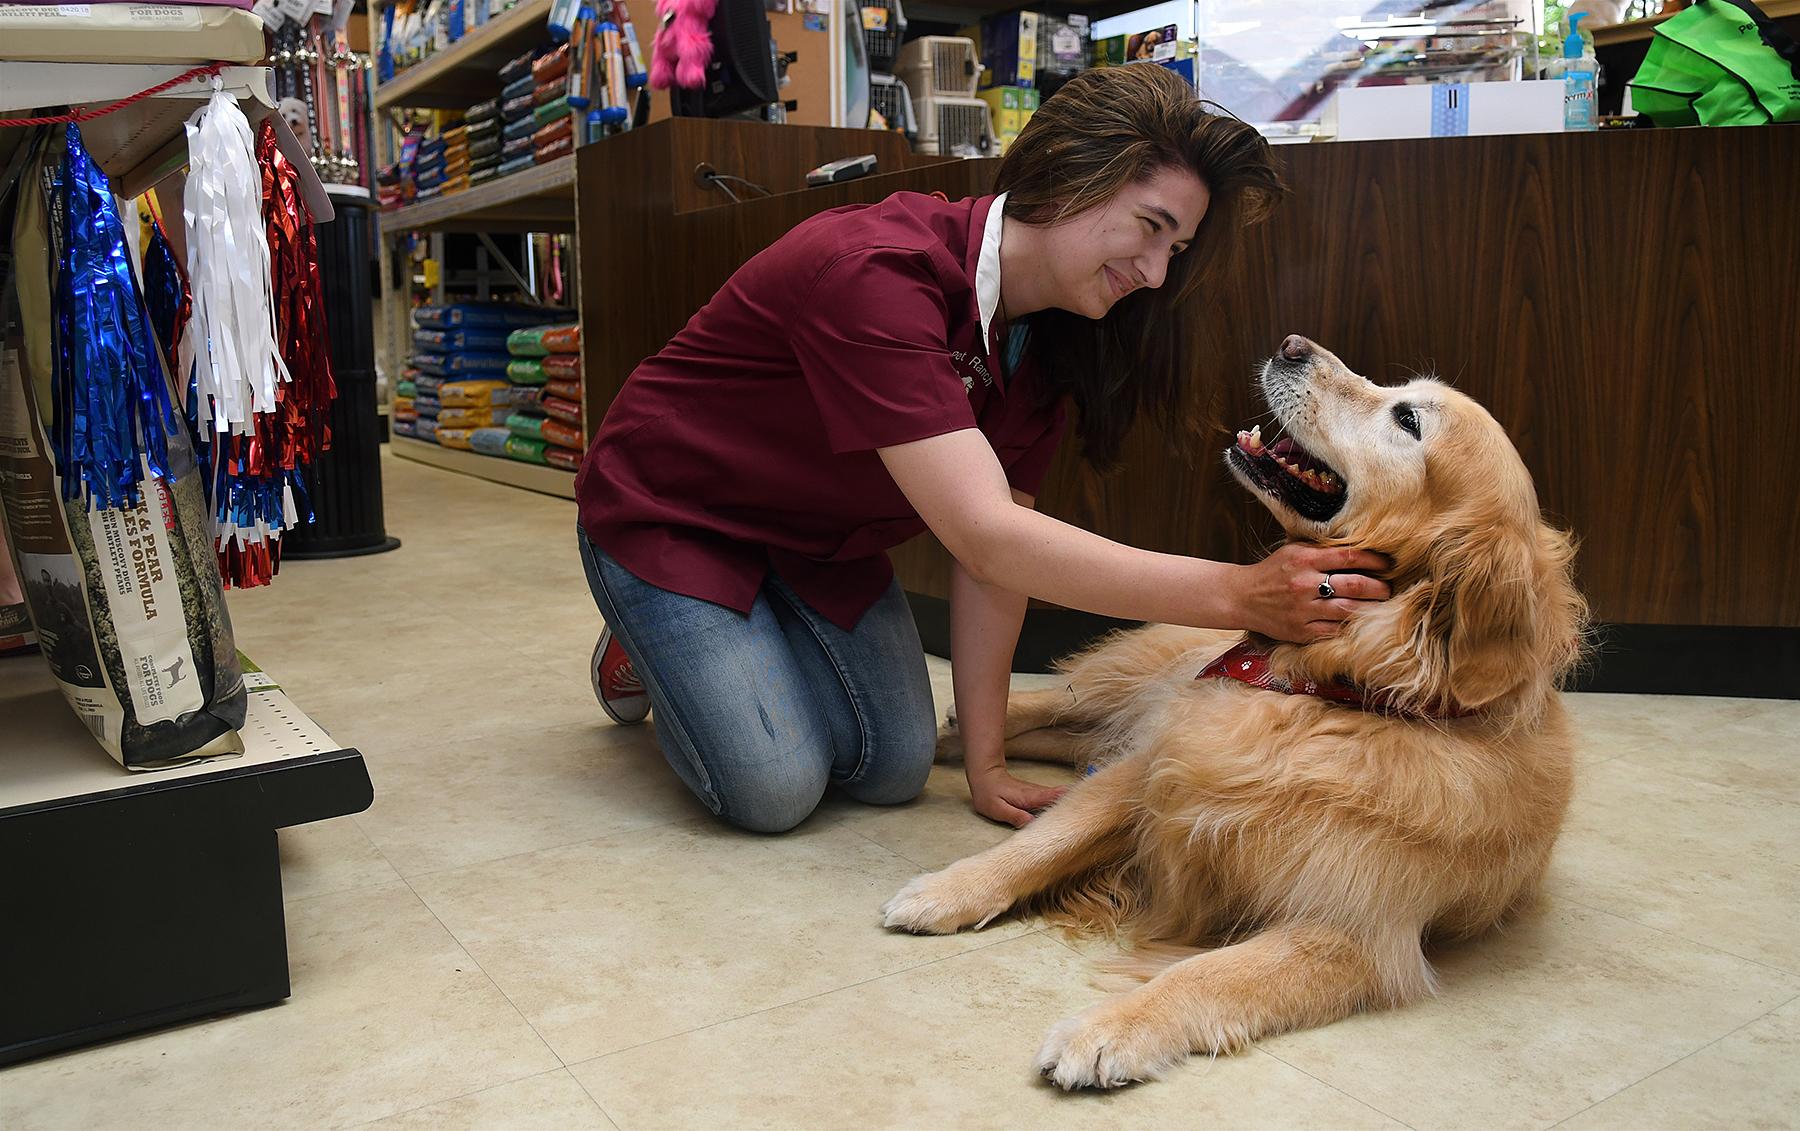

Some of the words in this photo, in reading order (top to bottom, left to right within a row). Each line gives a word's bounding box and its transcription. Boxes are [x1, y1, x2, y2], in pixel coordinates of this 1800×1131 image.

[968, 356, 993, 387] Ranch
[138, 518, 152, 532] &
[104, 523, 120, 567] BARTLETT
[114, 568, 126, 596] PEARS
[112, 529, 128, 569] MUSCOVY
[122, 570, 133, 594] DUCK
[129, 538, 158, 621] FORMULA
[142, 533, 164, 584] PEAR
[139, 656, 152, 678] FOR
[145, 678, 159, 707] DOGS
[147, 654, 161, 688] COMPLETE
[156, 687, 164, 705] FOOD
